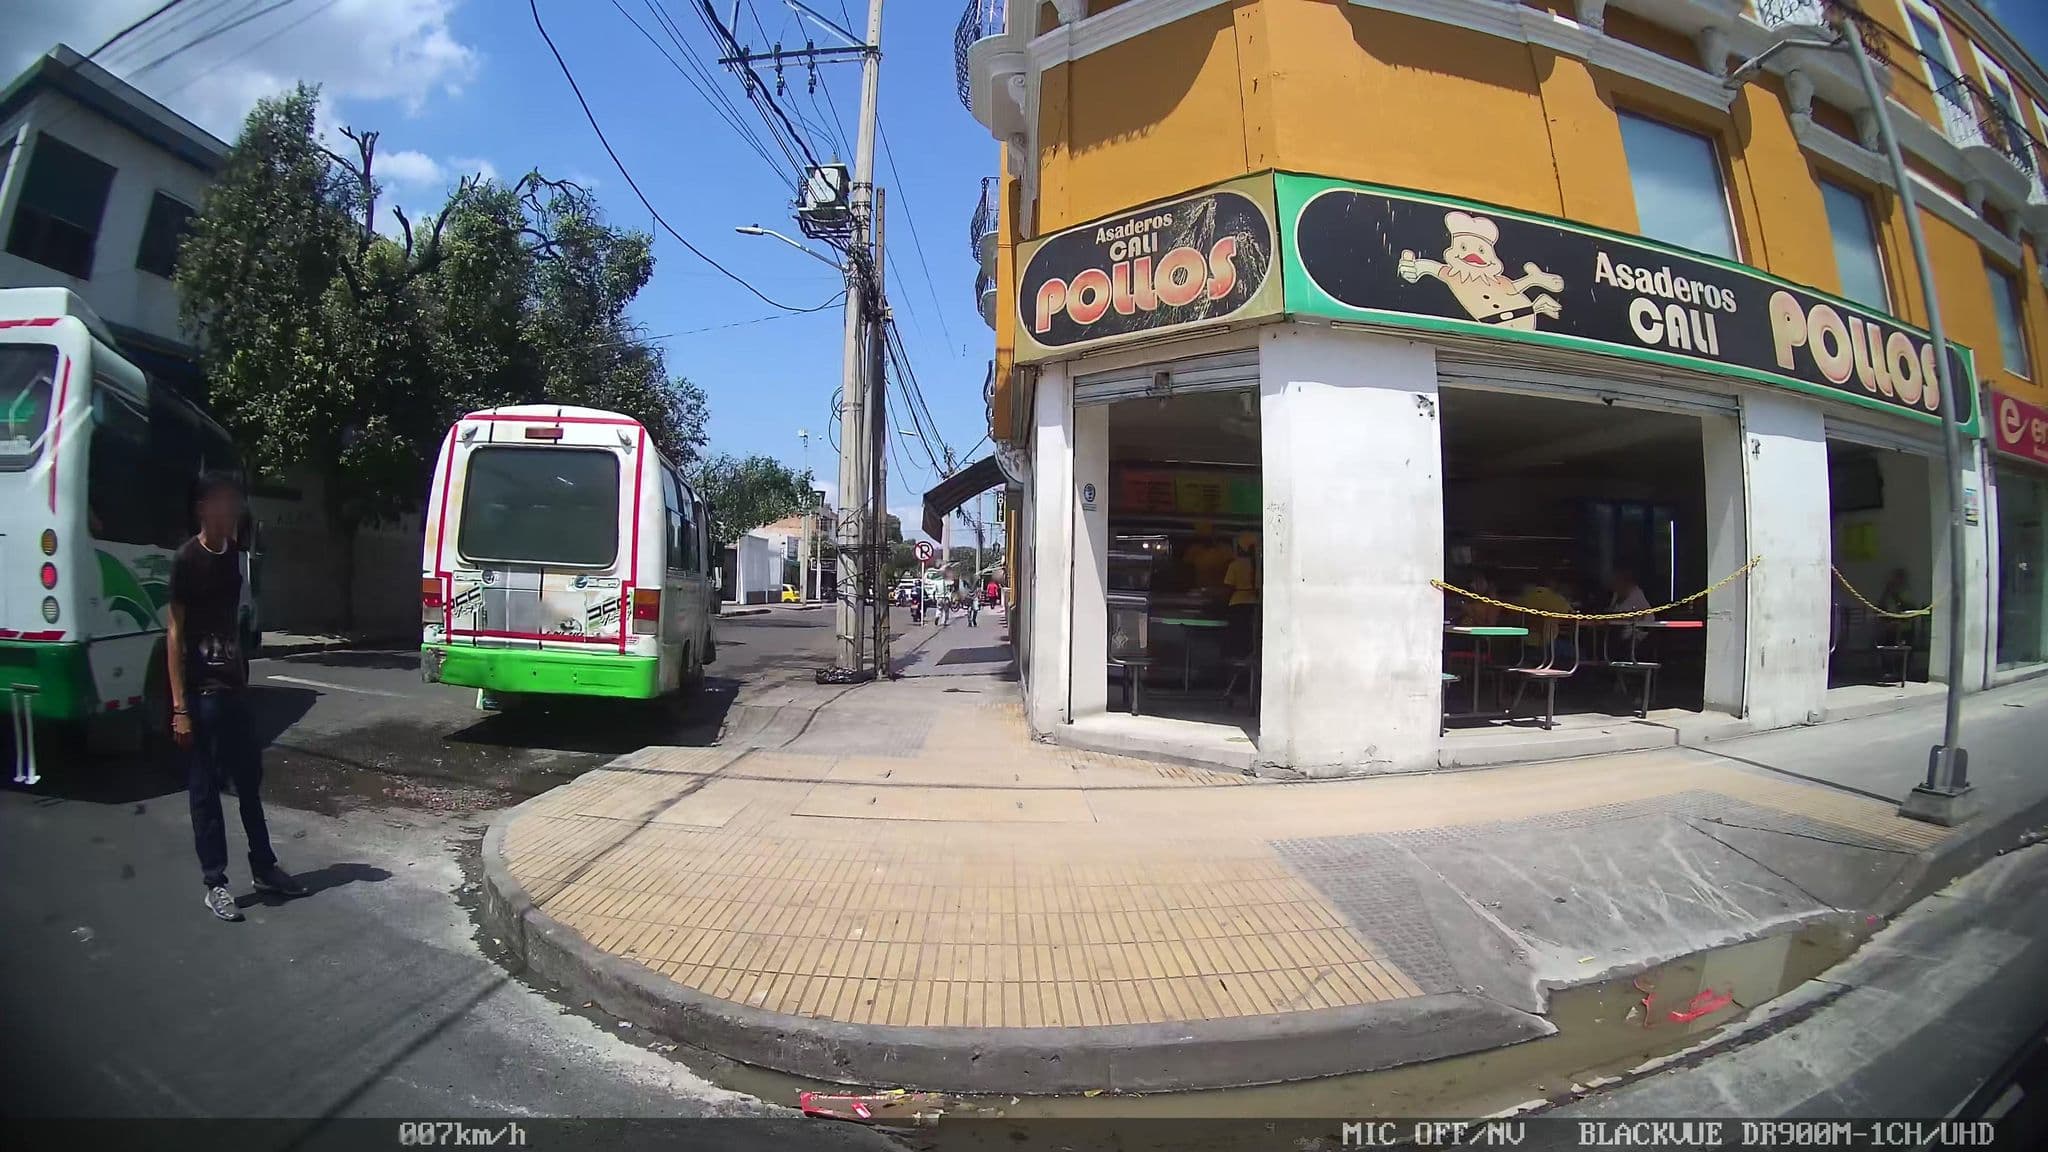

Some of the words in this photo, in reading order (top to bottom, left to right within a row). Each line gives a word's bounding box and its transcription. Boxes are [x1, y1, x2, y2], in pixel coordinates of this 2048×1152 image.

[1095, 211, 1173, 245] Asaderos
[1109, 232, 1159, 262] CALI
[1035, 236, 1237, 334] POLLOS
[1595, 251, 1737, 313] Asaderos
[1629, 297, 1720, 356] CALI
[1769, 290, 1941, 411] POLLOS
